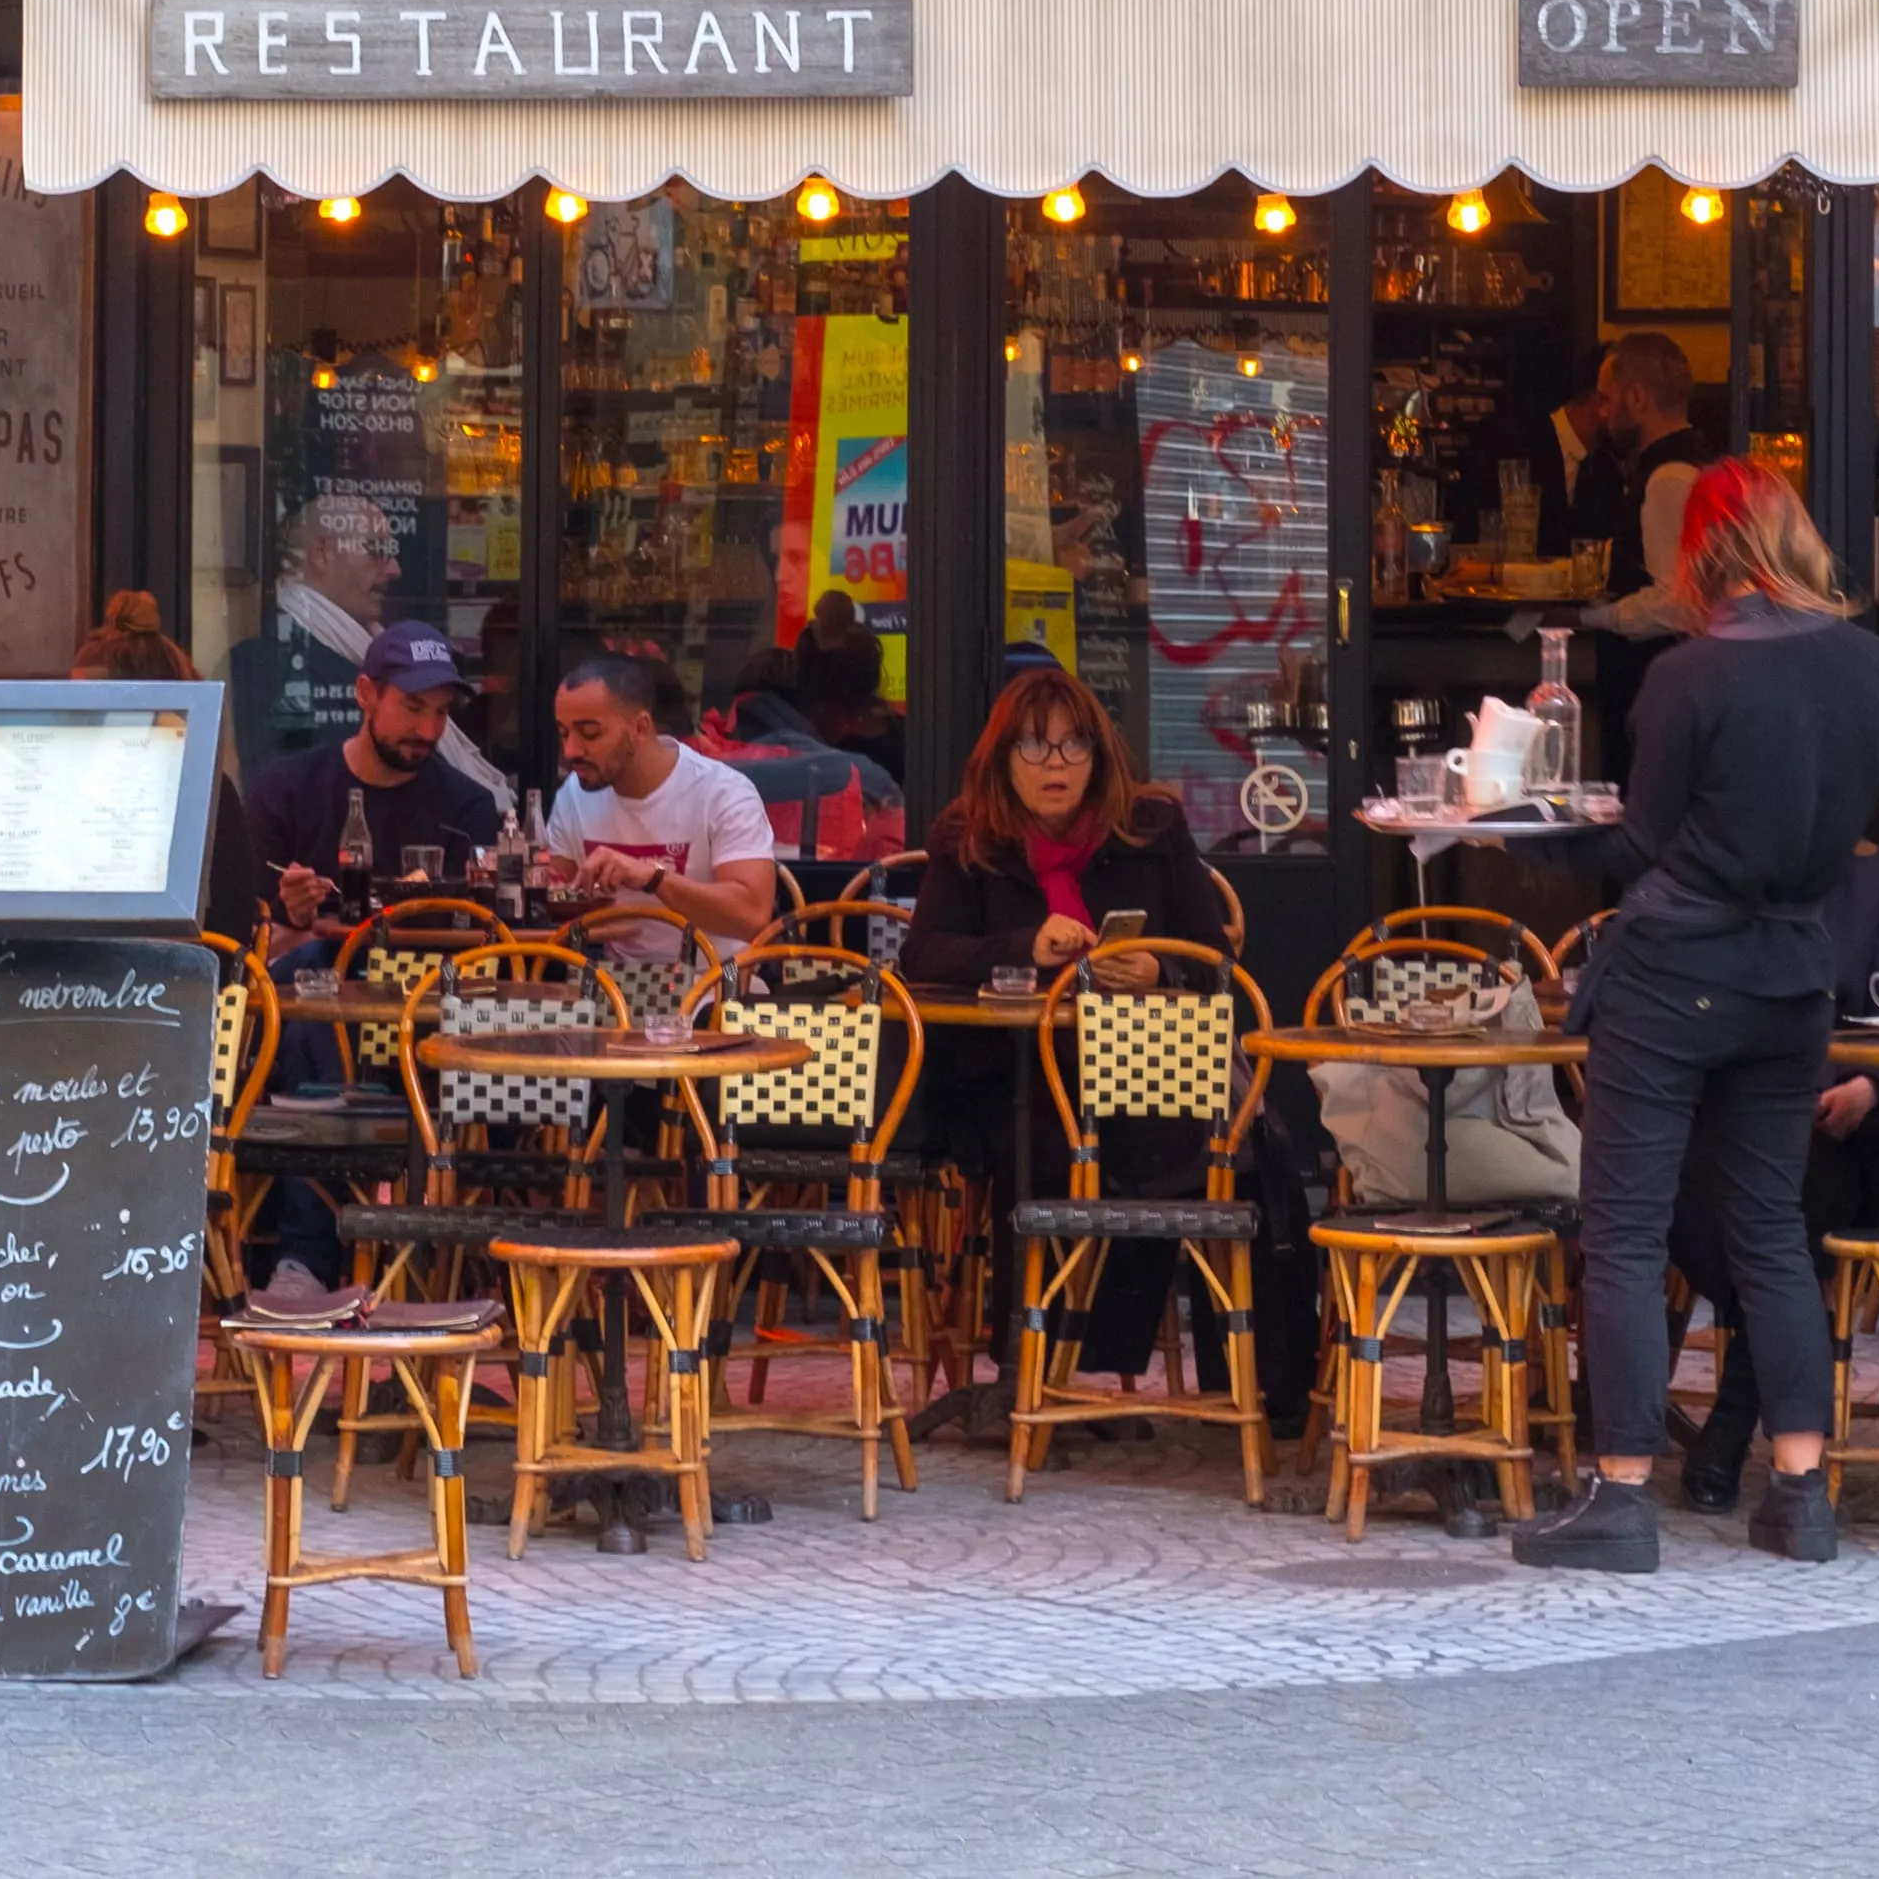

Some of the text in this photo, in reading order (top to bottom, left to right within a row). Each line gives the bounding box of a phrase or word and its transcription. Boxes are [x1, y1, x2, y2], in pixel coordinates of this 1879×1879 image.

[183, 9, 874, 77] RESTAURANT
[19, 968, 181, 1017] novembre
[13, 1064, 109, 1106] moules
[116, 1060, 160, 1098] et
[6, 1119, 89, 1175] pesto
[13, 1578, 96, 1620] vanille
